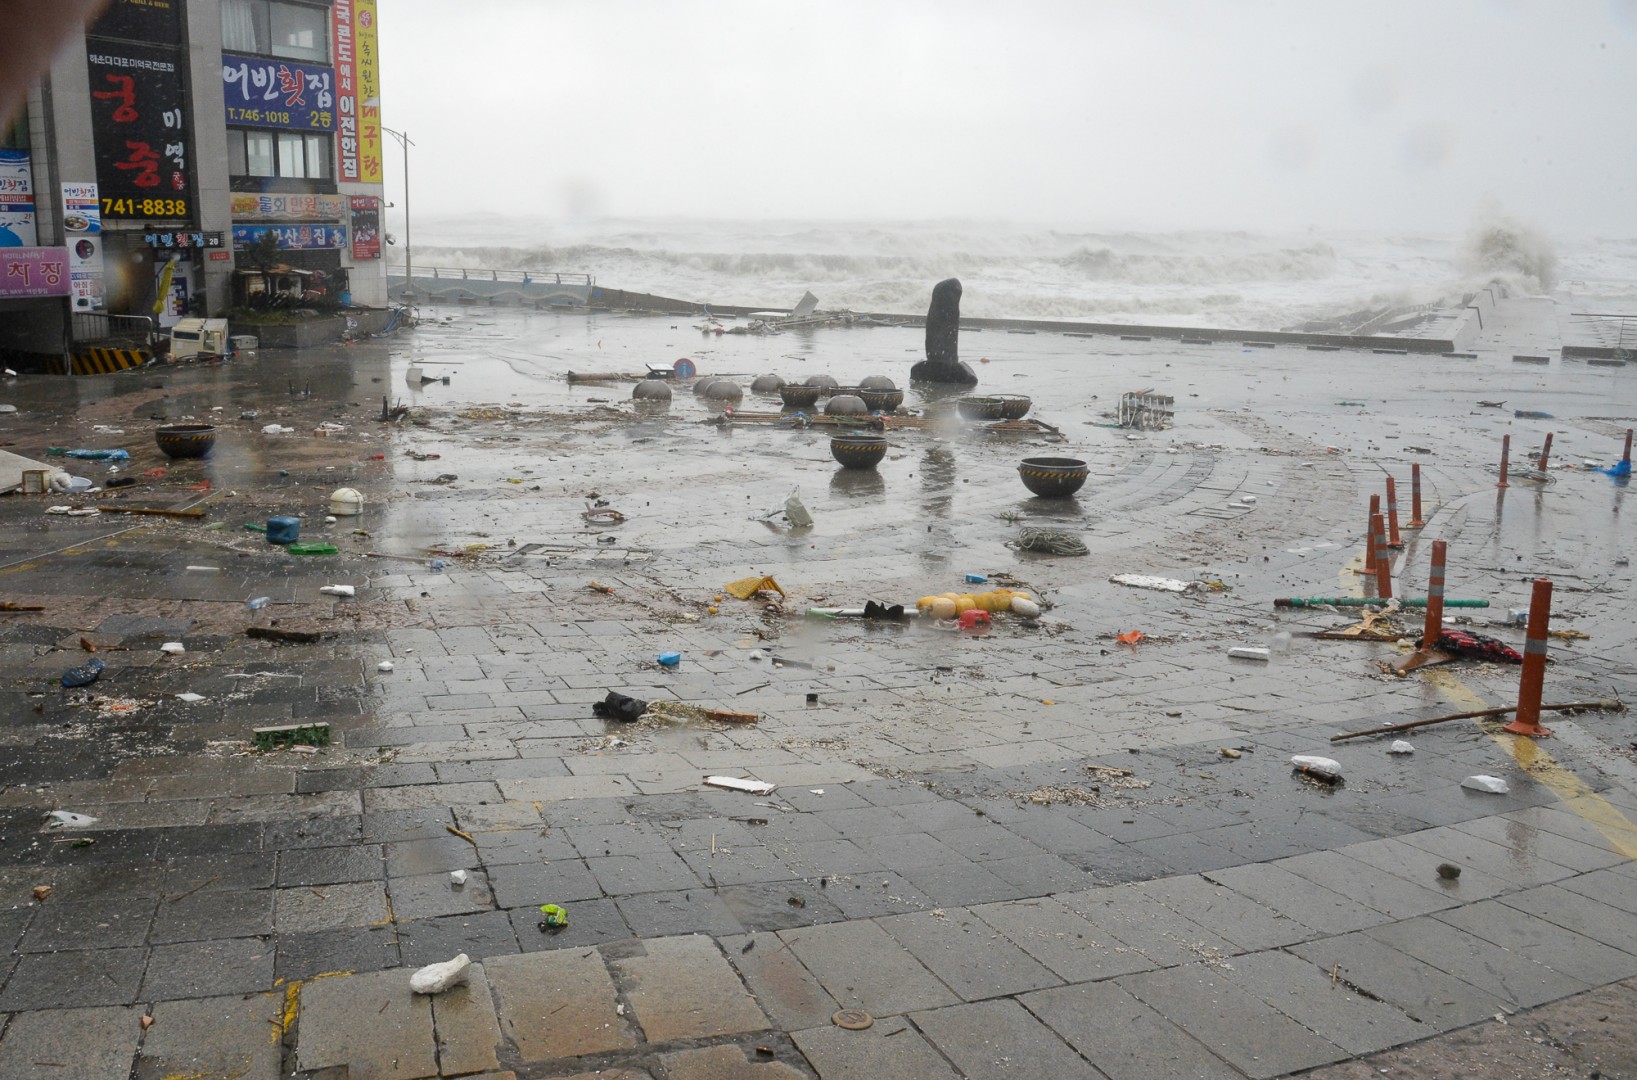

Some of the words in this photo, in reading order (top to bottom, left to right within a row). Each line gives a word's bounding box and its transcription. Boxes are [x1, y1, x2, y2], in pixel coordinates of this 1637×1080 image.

[336, 0, 352, 90] 국콘도에서
[222, 63, 333, 109] 어빈횟집
[162, 108, 184, 169] 미역
[310, 110, 332, 128] 2층
[340, 95, 358, 178] 이전한집
[361, 105, 380, 177] 대구탕
[102, 198, 186, 215] 741-8838
[145, 232, 204, 248] 어빈횟집
